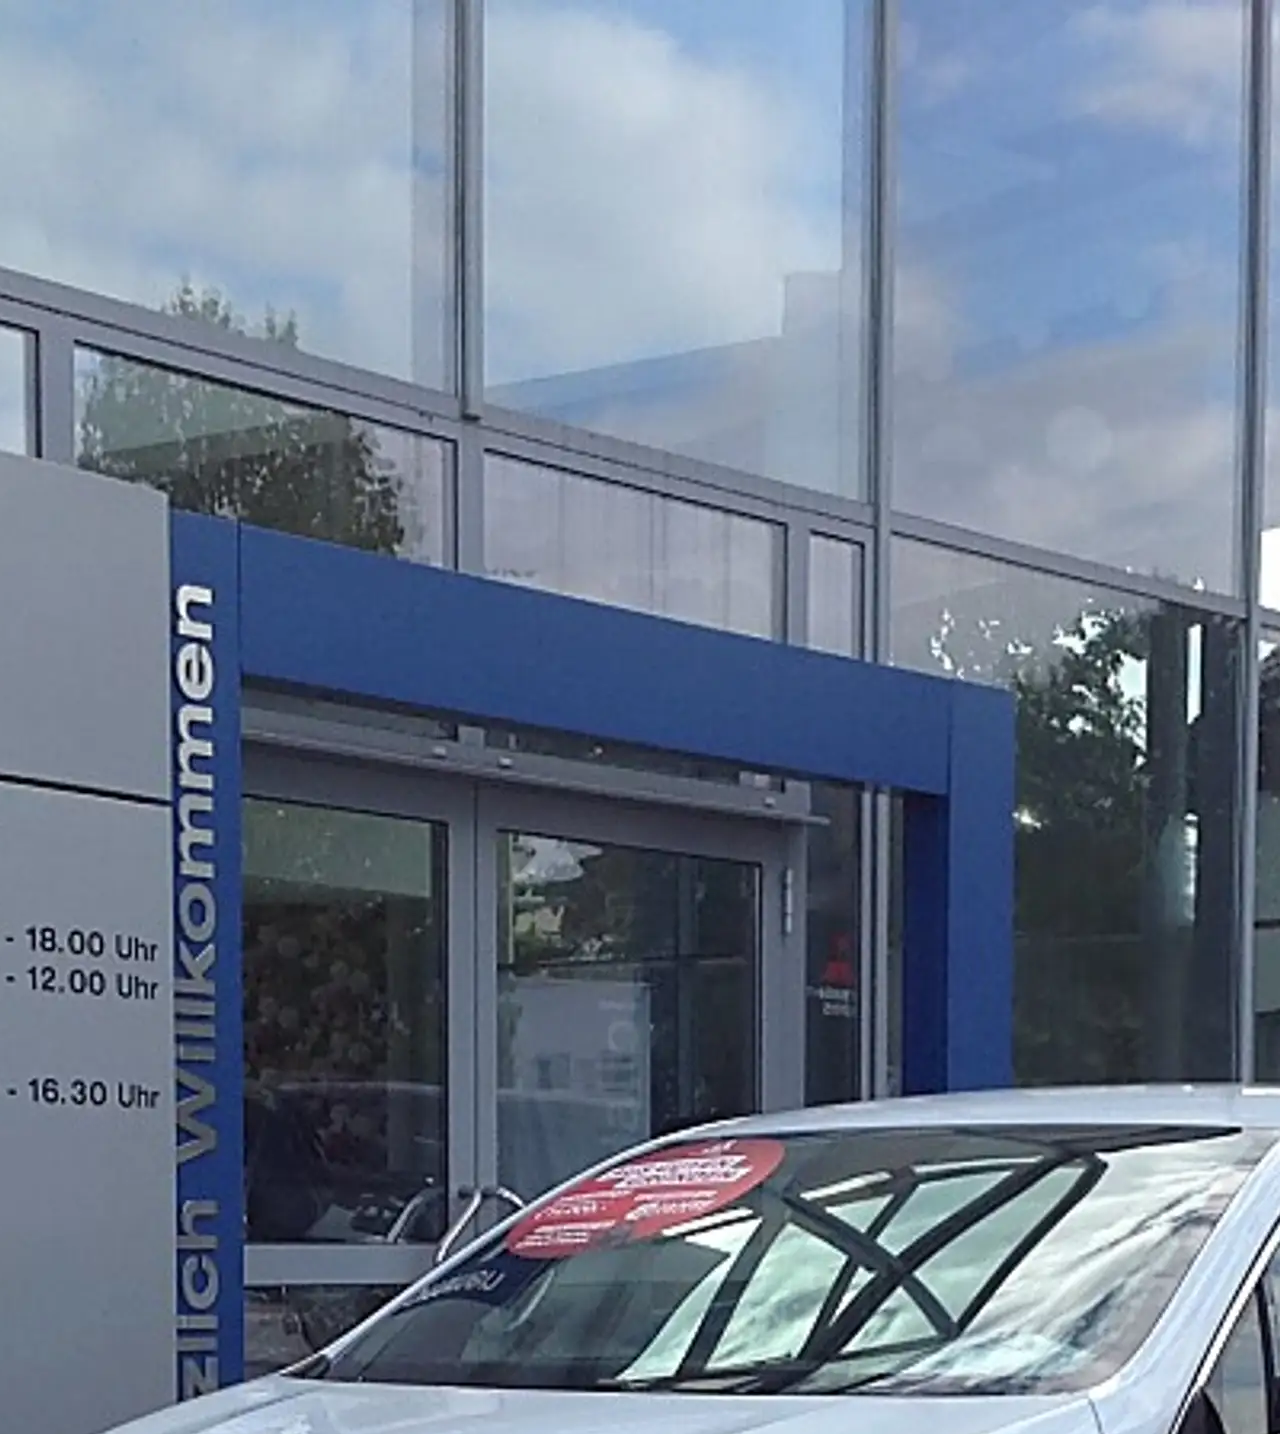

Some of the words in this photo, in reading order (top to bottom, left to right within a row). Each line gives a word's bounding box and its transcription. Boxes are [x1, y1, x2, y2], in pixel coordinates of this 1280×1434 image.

[175, 583, 218, 1165] Willkommen
[25, 926, 105, 958] 18.00
[115, 934, 159, 962] Uhr
[26, 966, 107, 996] 12.00
[116, 973, 159, 1000] Uhr
[28, 1078, 109, 1106] 16.30
[117, 1082, 160, 1109] Uhr
